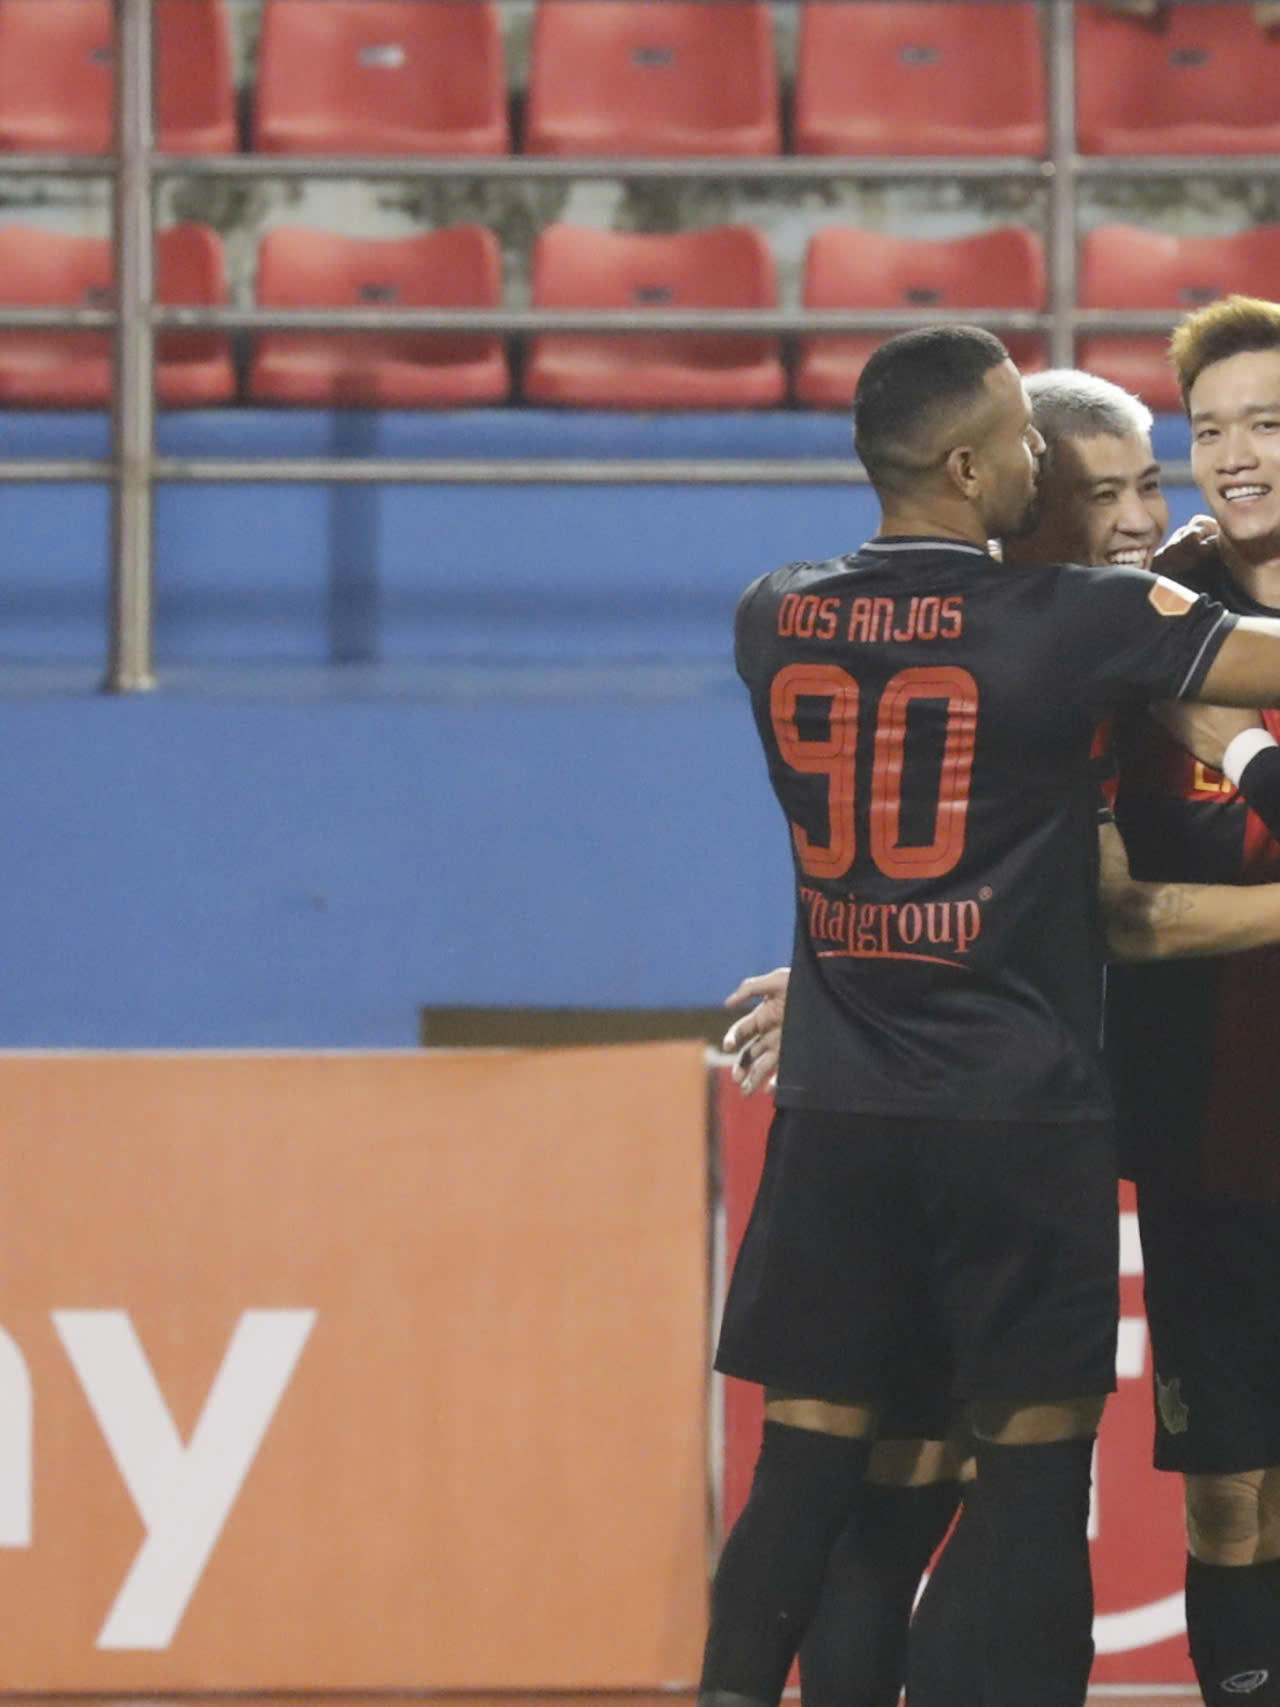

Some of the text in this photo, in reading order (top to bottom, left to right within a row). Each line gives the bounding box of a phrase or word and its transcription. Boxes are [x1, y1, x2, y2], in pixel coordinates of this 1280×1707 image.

[777, 593, 965, 643] DOS ANJOS
[770, 663, 980, 880] 90
